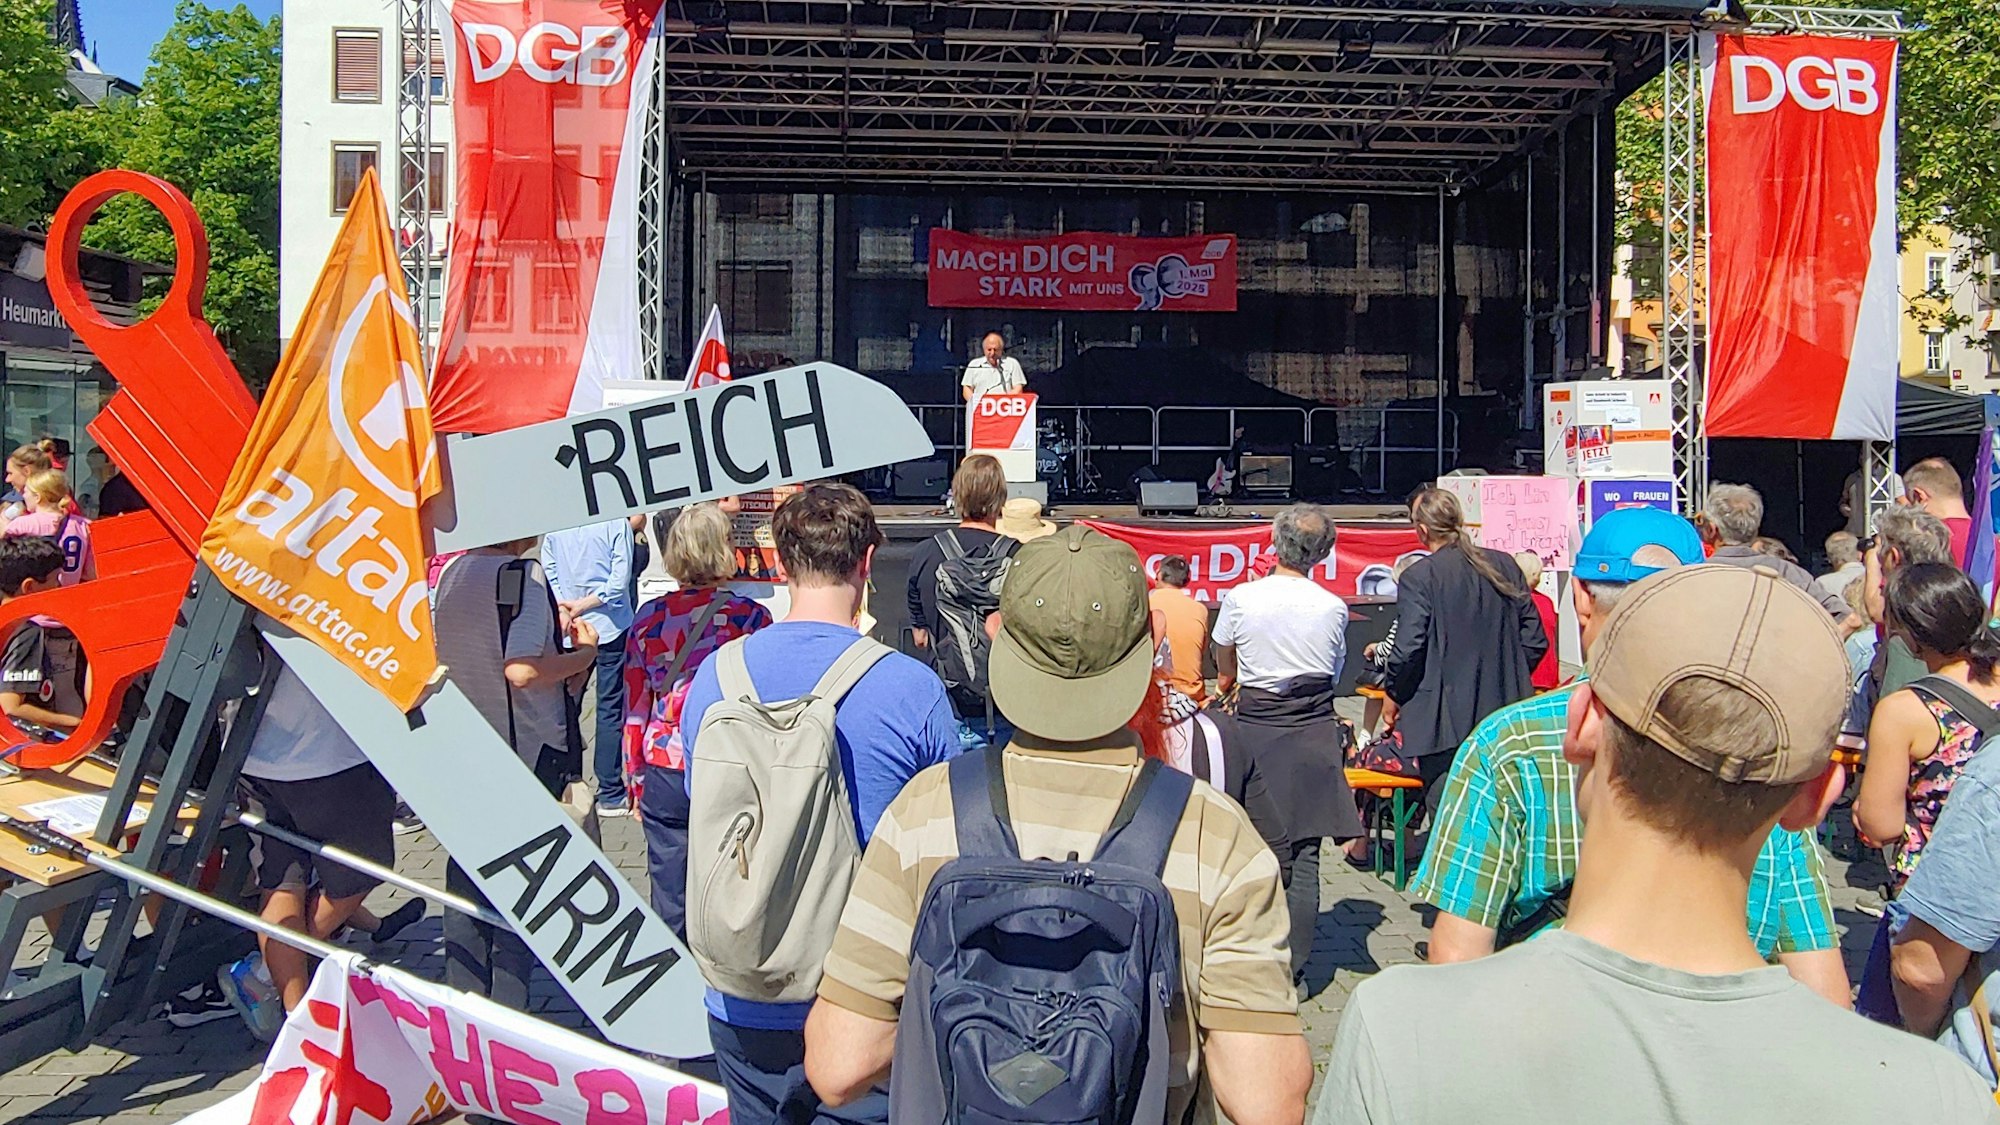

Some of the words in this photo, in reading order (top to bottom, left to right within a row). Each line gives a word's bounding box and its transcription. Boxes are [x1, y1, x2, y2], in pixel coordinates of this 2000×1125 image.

[462, 22, 630, 86] DGB
[1730, 55, 1879, 115] DGB
[936, 249, 1016, 271] MACH
[1023, 244, 1114, 273] DICH
[1189, 267, 1212, 280] Mai
[979, 276, 1062, 298] STARK
[1069, 283, 1093, 295] MIT
[1096, 283, 1124, 295] UNS
[1177, 281, 1205, 293] 2025
[981, 397, 1027, 417] DGB
[572, 370, 834, 516] REICH
[1583, 447, 1610, 461] JETZT
[1483, 483, 1516, 505] Ich
[1604, 492, 1621, 502] WO
[1633, 491, 1669, 501] FRAUEN
[235, 467, 428, 642] attac
[214, 546, 400, 681] www.attac.de
[477, 824, 681, 1026] ARM
